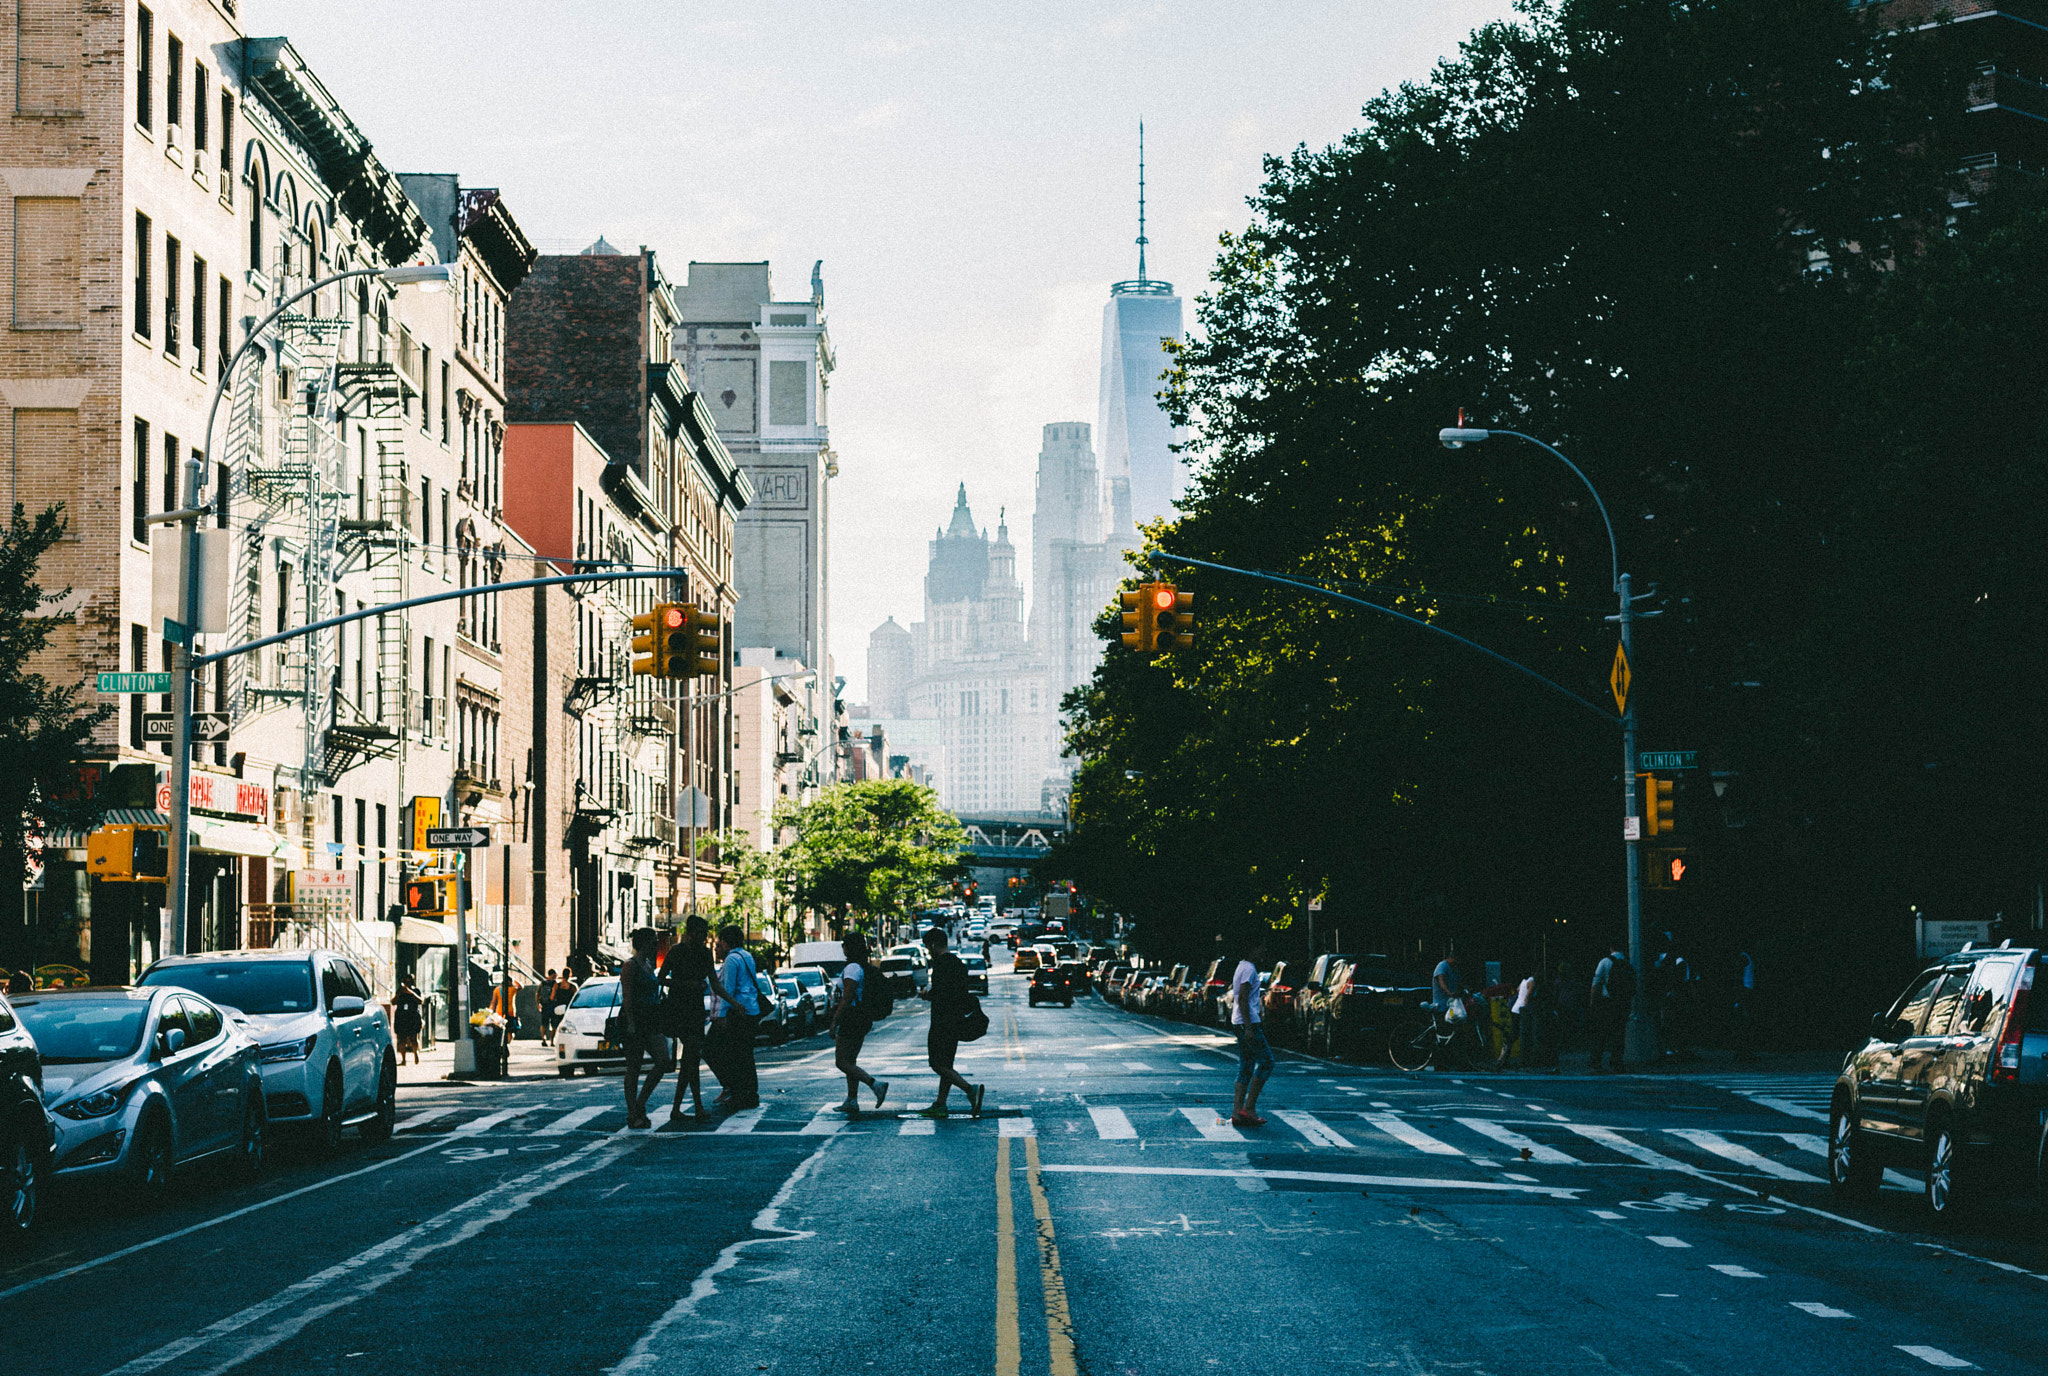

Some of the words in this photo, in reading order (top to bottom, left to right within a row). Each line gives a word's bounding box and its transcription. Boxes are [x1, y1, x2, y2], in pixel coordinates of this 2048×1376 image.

[101, 674, 155, 691] CLINTON
[158, 674, 169, 683] ST
[150, 721, 174, 733] ONE
[192, 721, 218, 733] WAY
[1643, 754, 1682, 768] CLINTON
[190, 775, 214, 808] PPLE
[432, 834, 450, 843] ONE
[454, 833, 473, 842] WAY
